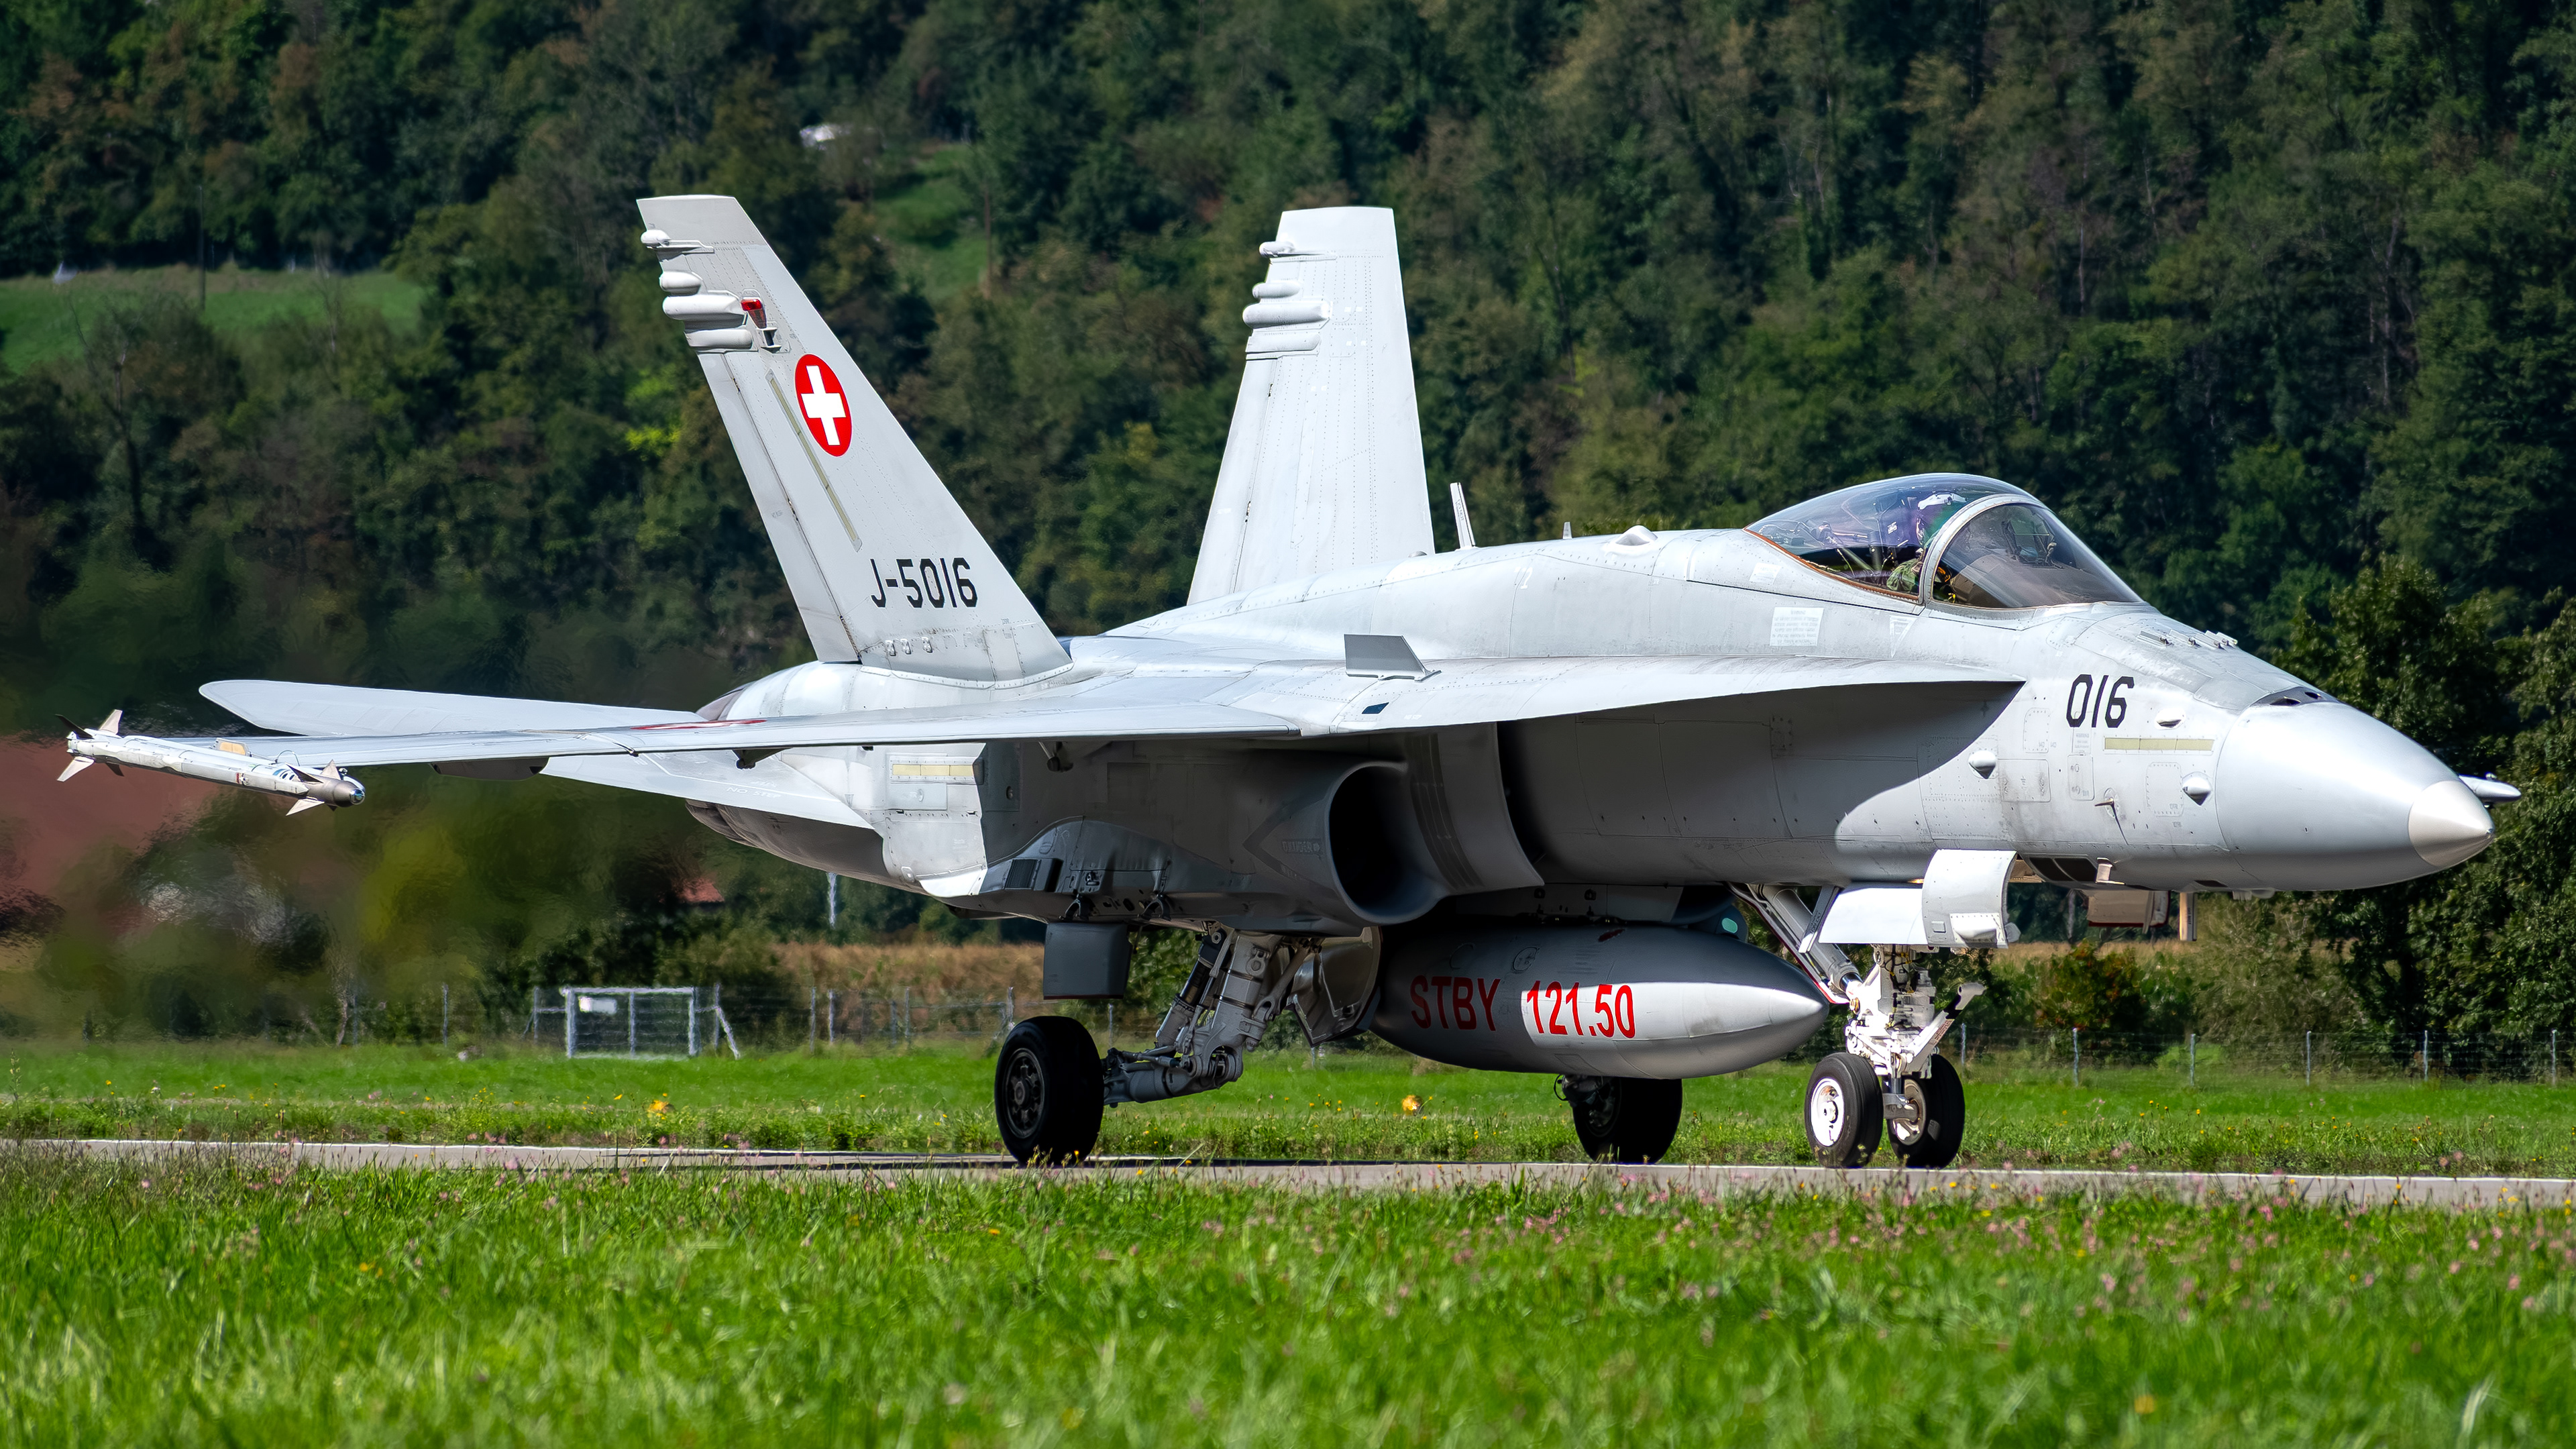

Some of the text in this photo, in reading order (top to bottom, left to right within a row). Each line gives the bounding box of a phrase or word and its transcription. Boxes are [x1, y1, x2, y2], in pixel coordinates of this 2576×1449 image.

[870, 557, 978, 608] J-5016
[2066, 674, 2135, 729] 016
[1410, 975, 1636, 1038] STBY 121.50
